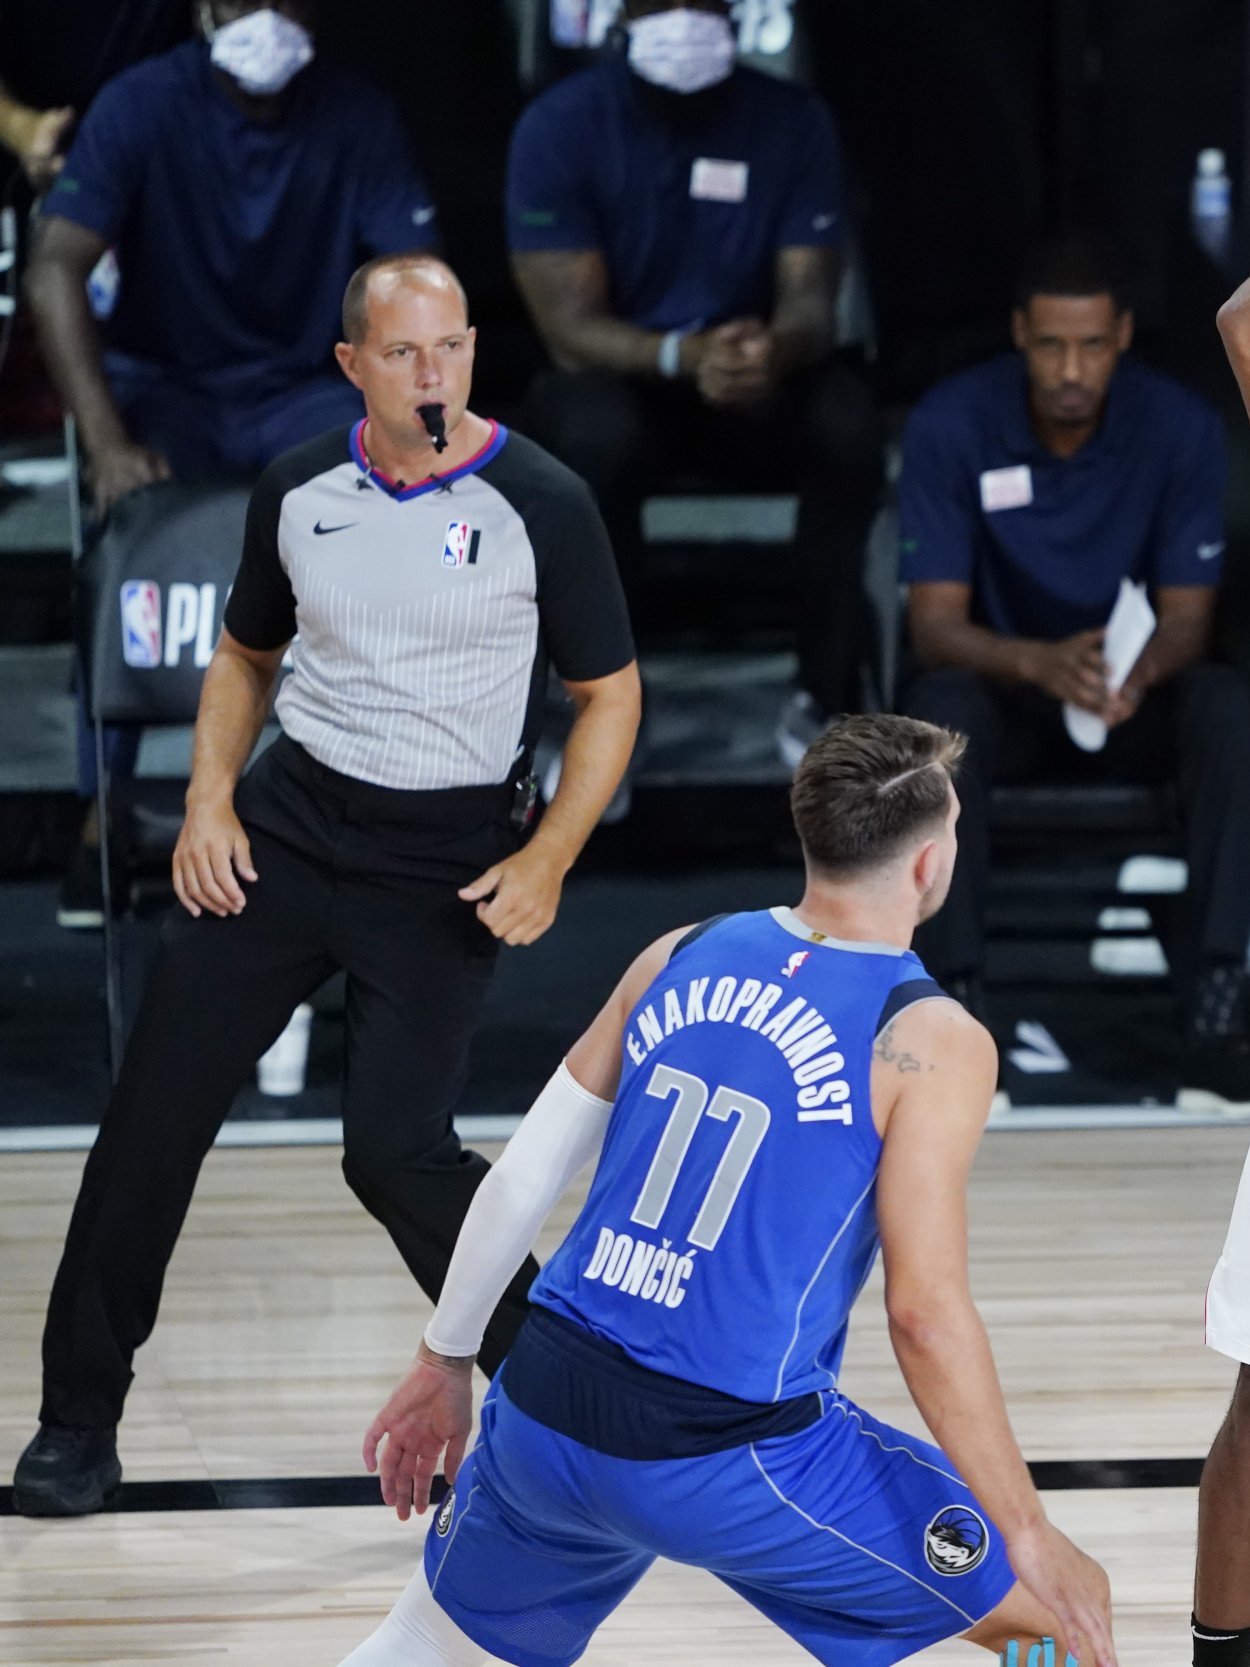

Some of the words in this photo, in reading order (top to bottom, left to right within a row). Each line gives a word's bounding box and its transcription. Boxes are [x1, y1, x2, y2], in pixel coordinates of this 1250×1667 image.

[163, 582, 233, 668] PL
[626, 975, 853, 1126] ENAKOPRAVNOST
[630, 1063, 771, 1252] 77
[583, 1226, 697, 1309] DONČIĆ
